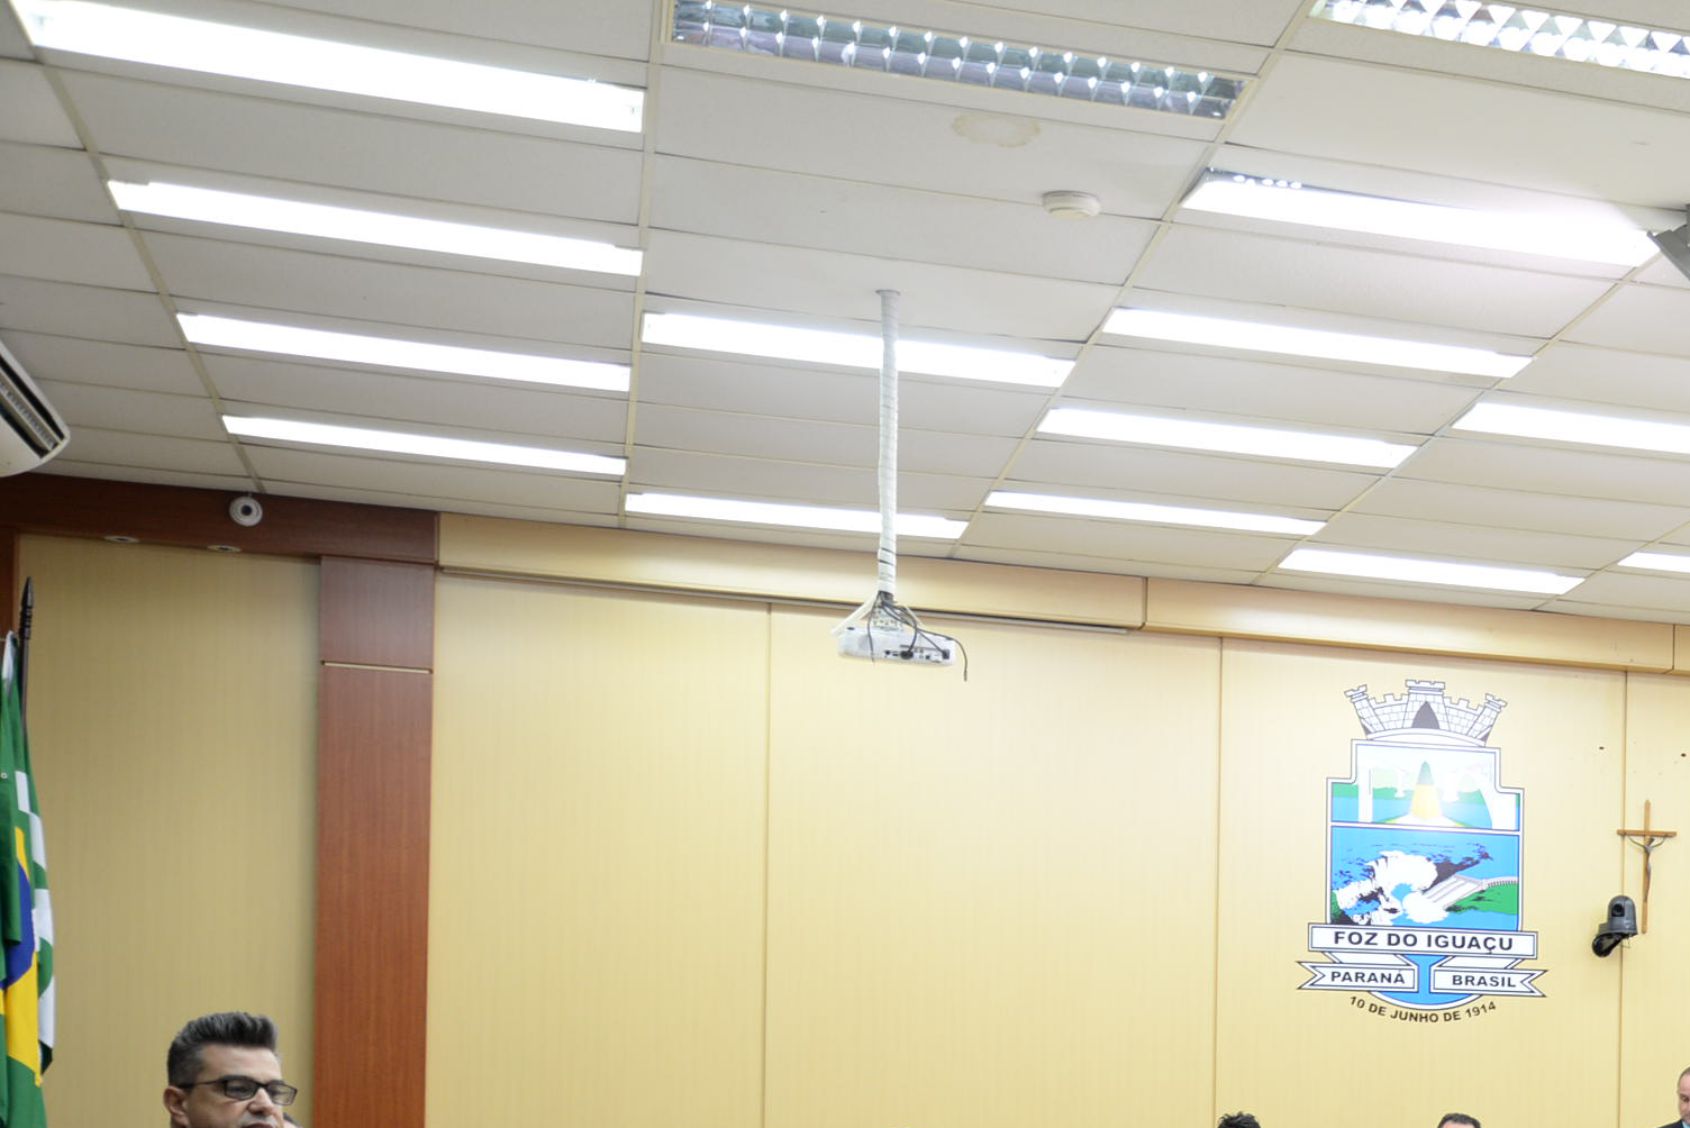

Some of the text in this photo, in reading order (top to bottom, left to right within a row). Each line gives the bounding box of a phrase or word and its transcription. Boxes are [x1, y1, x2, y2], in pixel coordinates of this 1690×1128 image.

[1333, 930, 1514, 955] FOZ DO IGUAÇU
[1452, 974, 1517, 987] BRASIL
[1350, 996, 1496, 1023] 10 DE JUNHO DE 1914
